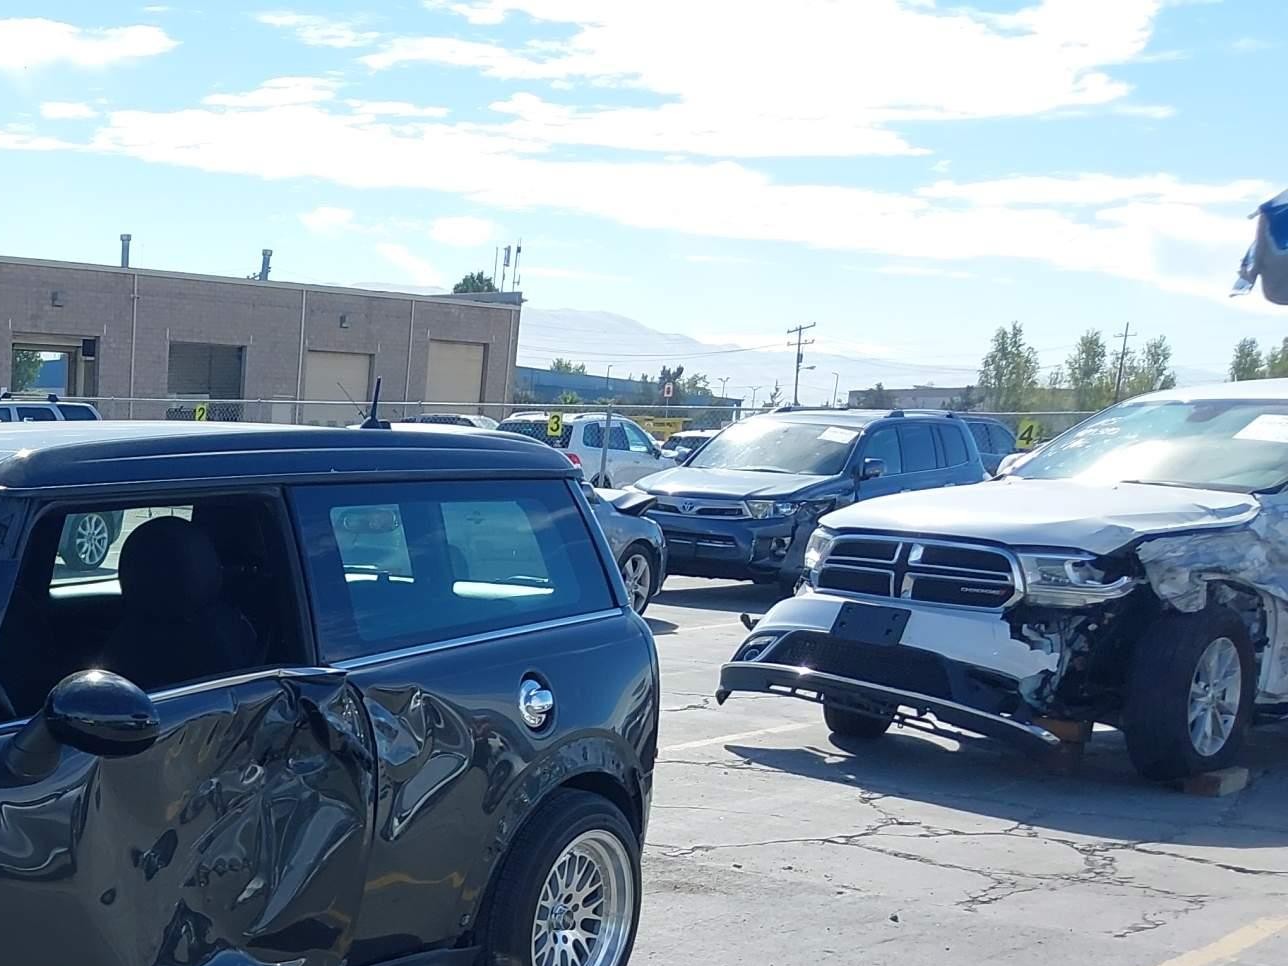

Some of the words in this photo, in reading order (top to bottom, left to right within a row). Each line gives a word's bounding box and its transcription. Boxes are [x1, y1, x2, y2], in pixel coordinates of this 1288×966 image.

[198, 407, 206, 421] 2
[550, 415, 560, 432] 3
[1019, 424, 1034, 445] 4
